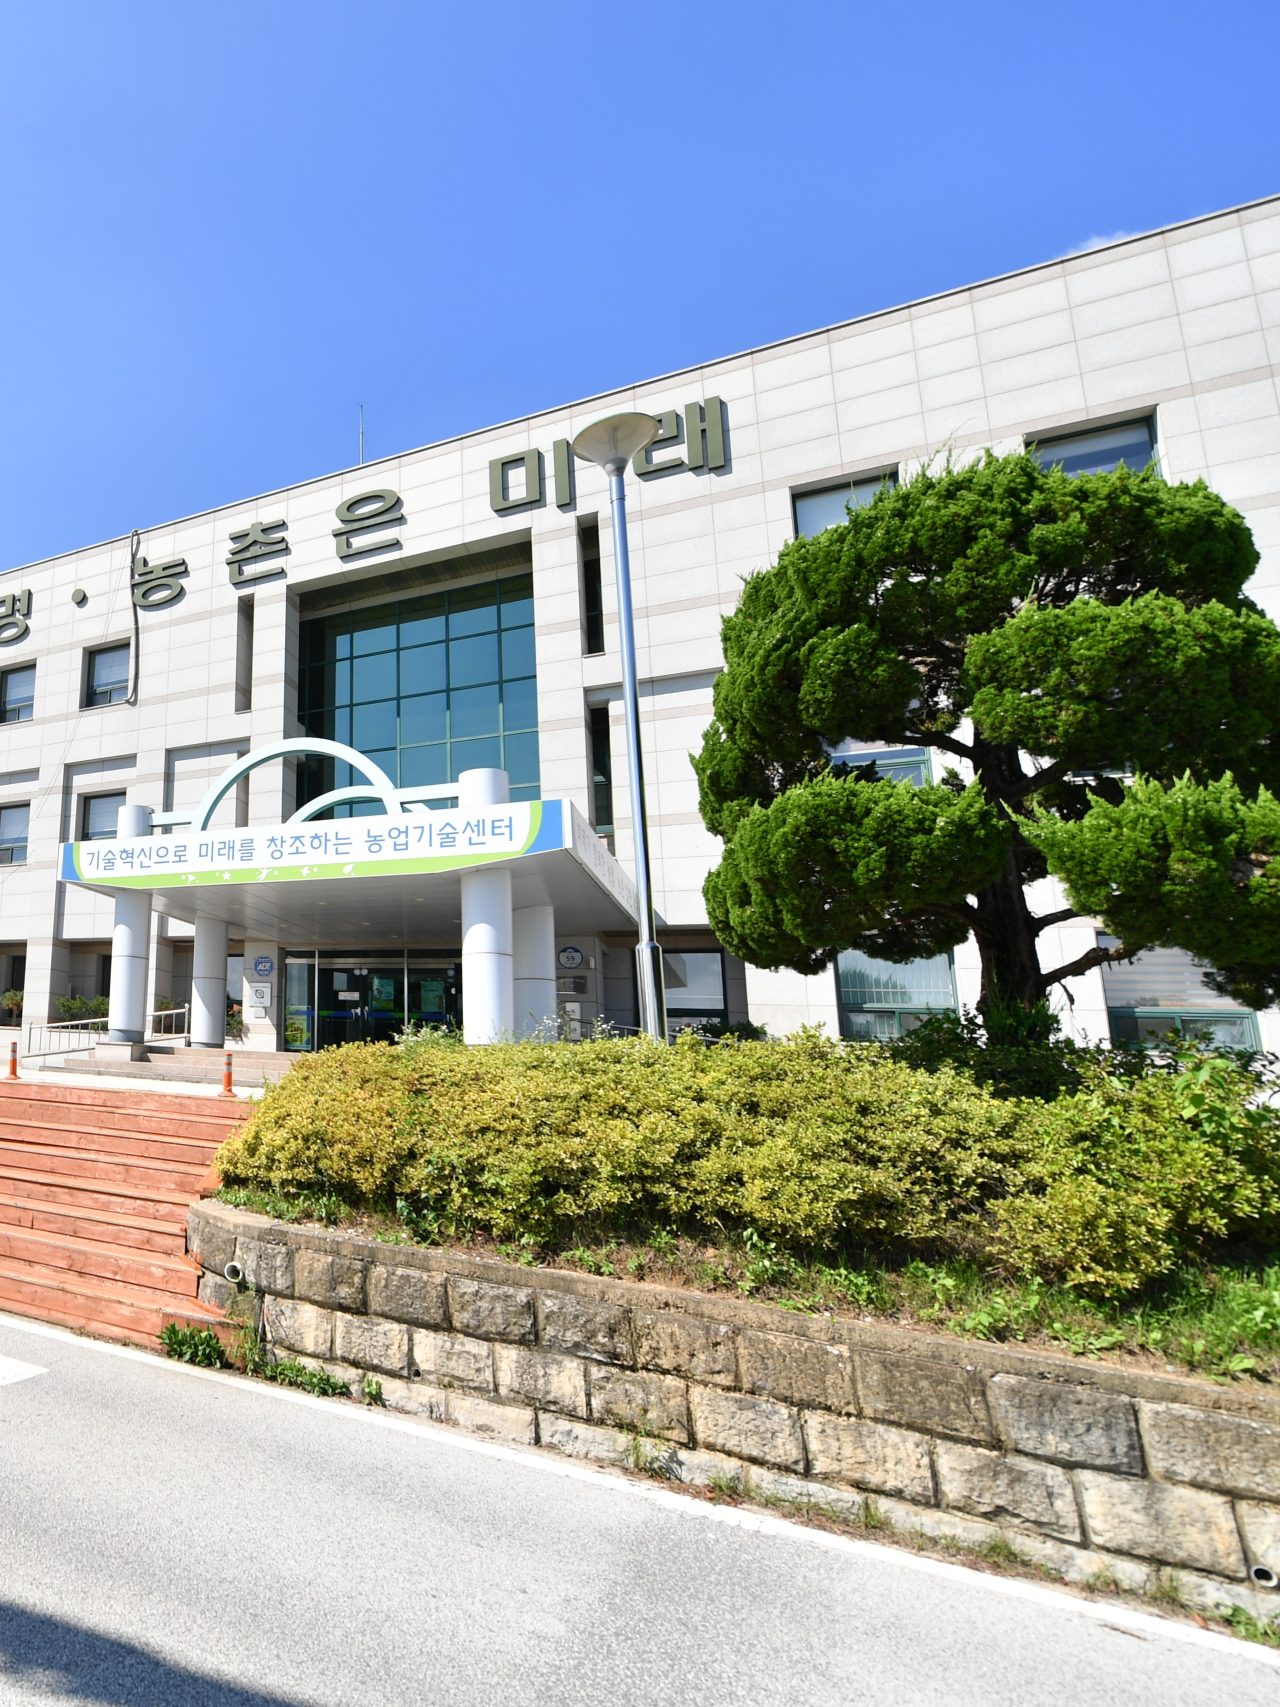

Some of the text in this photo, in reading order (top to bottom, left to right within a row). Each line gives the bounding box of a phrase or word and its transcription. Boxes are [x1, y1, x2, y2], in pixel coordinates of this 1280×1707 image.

[131, 488, 404, 606] 농촌은
[489, 396, 727, 512] 미래
[86, 815, 515, 871] 기술혁신으로 미래를 창조하는 농업기술센터
